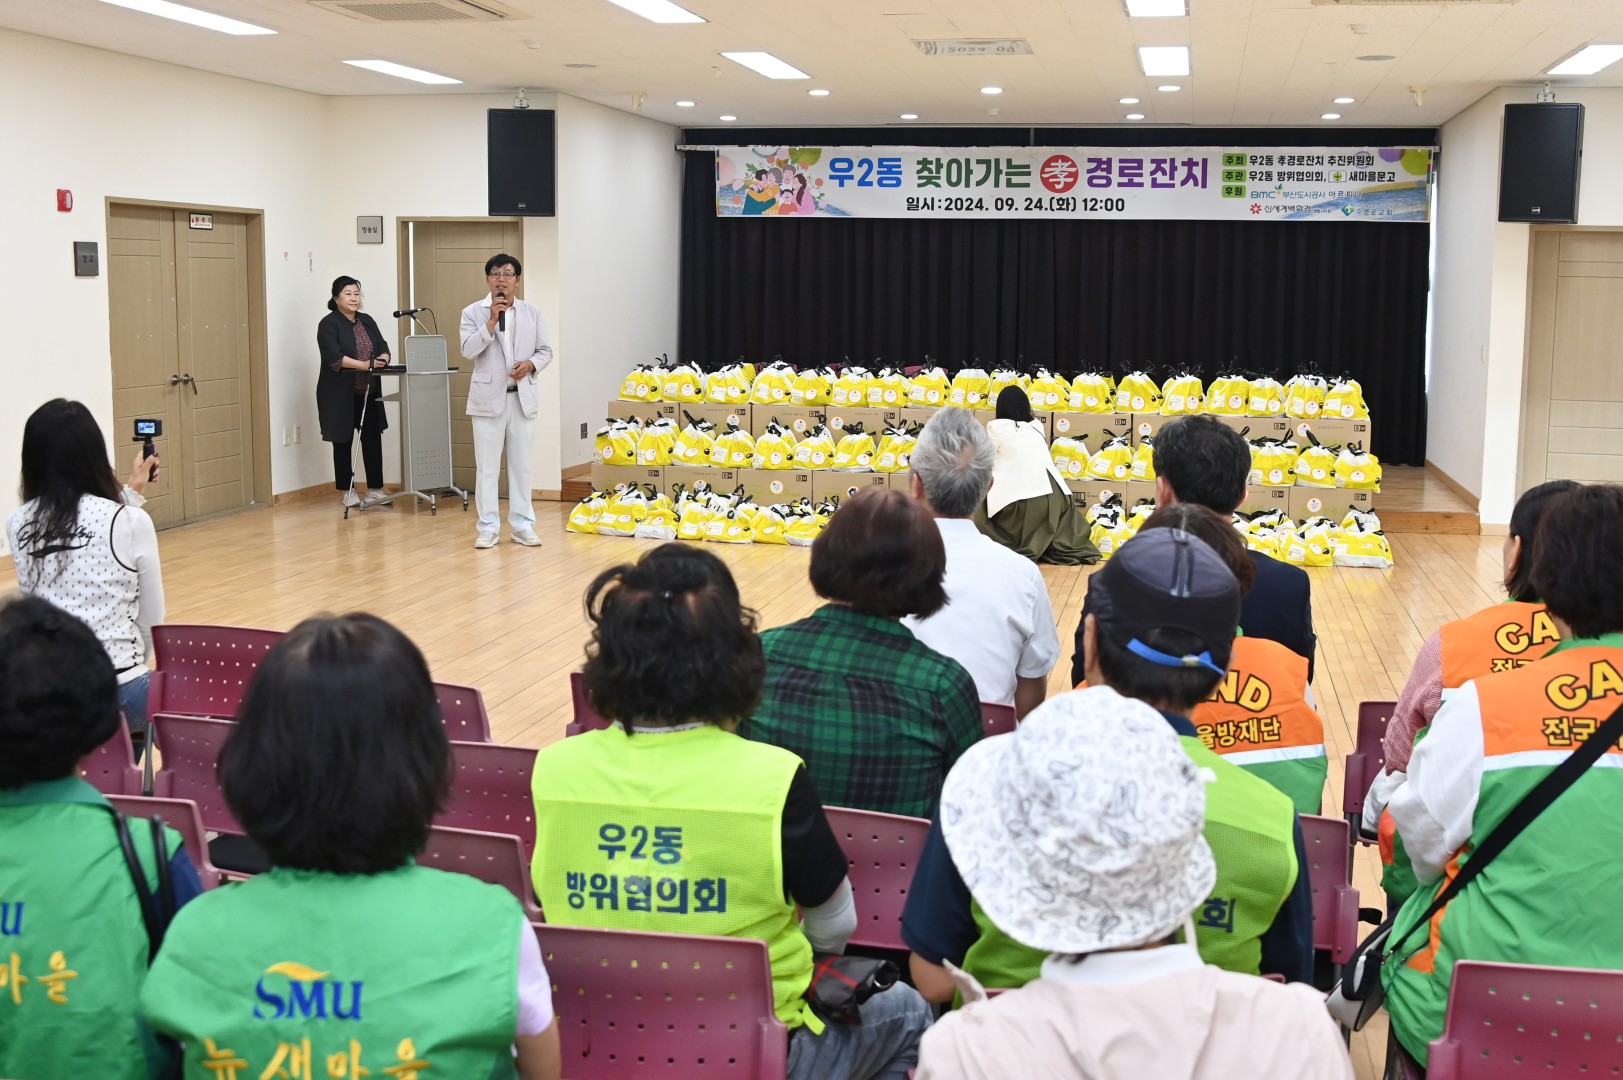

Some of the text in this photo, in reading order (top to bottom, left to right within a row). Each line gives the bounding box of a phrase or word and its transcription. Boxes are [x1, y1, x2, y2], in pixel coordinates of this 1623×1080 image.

[1226, 156, 1244, 165] 주최
[1249, 155, 1274, 166] 우2동
[1328, 155, 1375, 166] 추진위원회
[828, 157, 903, 188] 우2동
[916, 157, 1032, 188] 찾아가는
[1086, 157, 1208, 189] 경로잔치
[1225, 171, 1244, 181] 주관
[1249, 171, 1273, 182] 우2동
[1349, 171, 1396, 182] 새마을문고
[1225, 187, 1243, 196] 후원
[906, 197, 989, 211] 일시:2024.
[994, 197, 1019, 211] 09.
[1082, 197, 1125, 211] 12:00
[598, 823, 682, 865] 우2동
[566, 871, 726, 914] 방위협의회
[253, 976, 363, 1021] SMU
